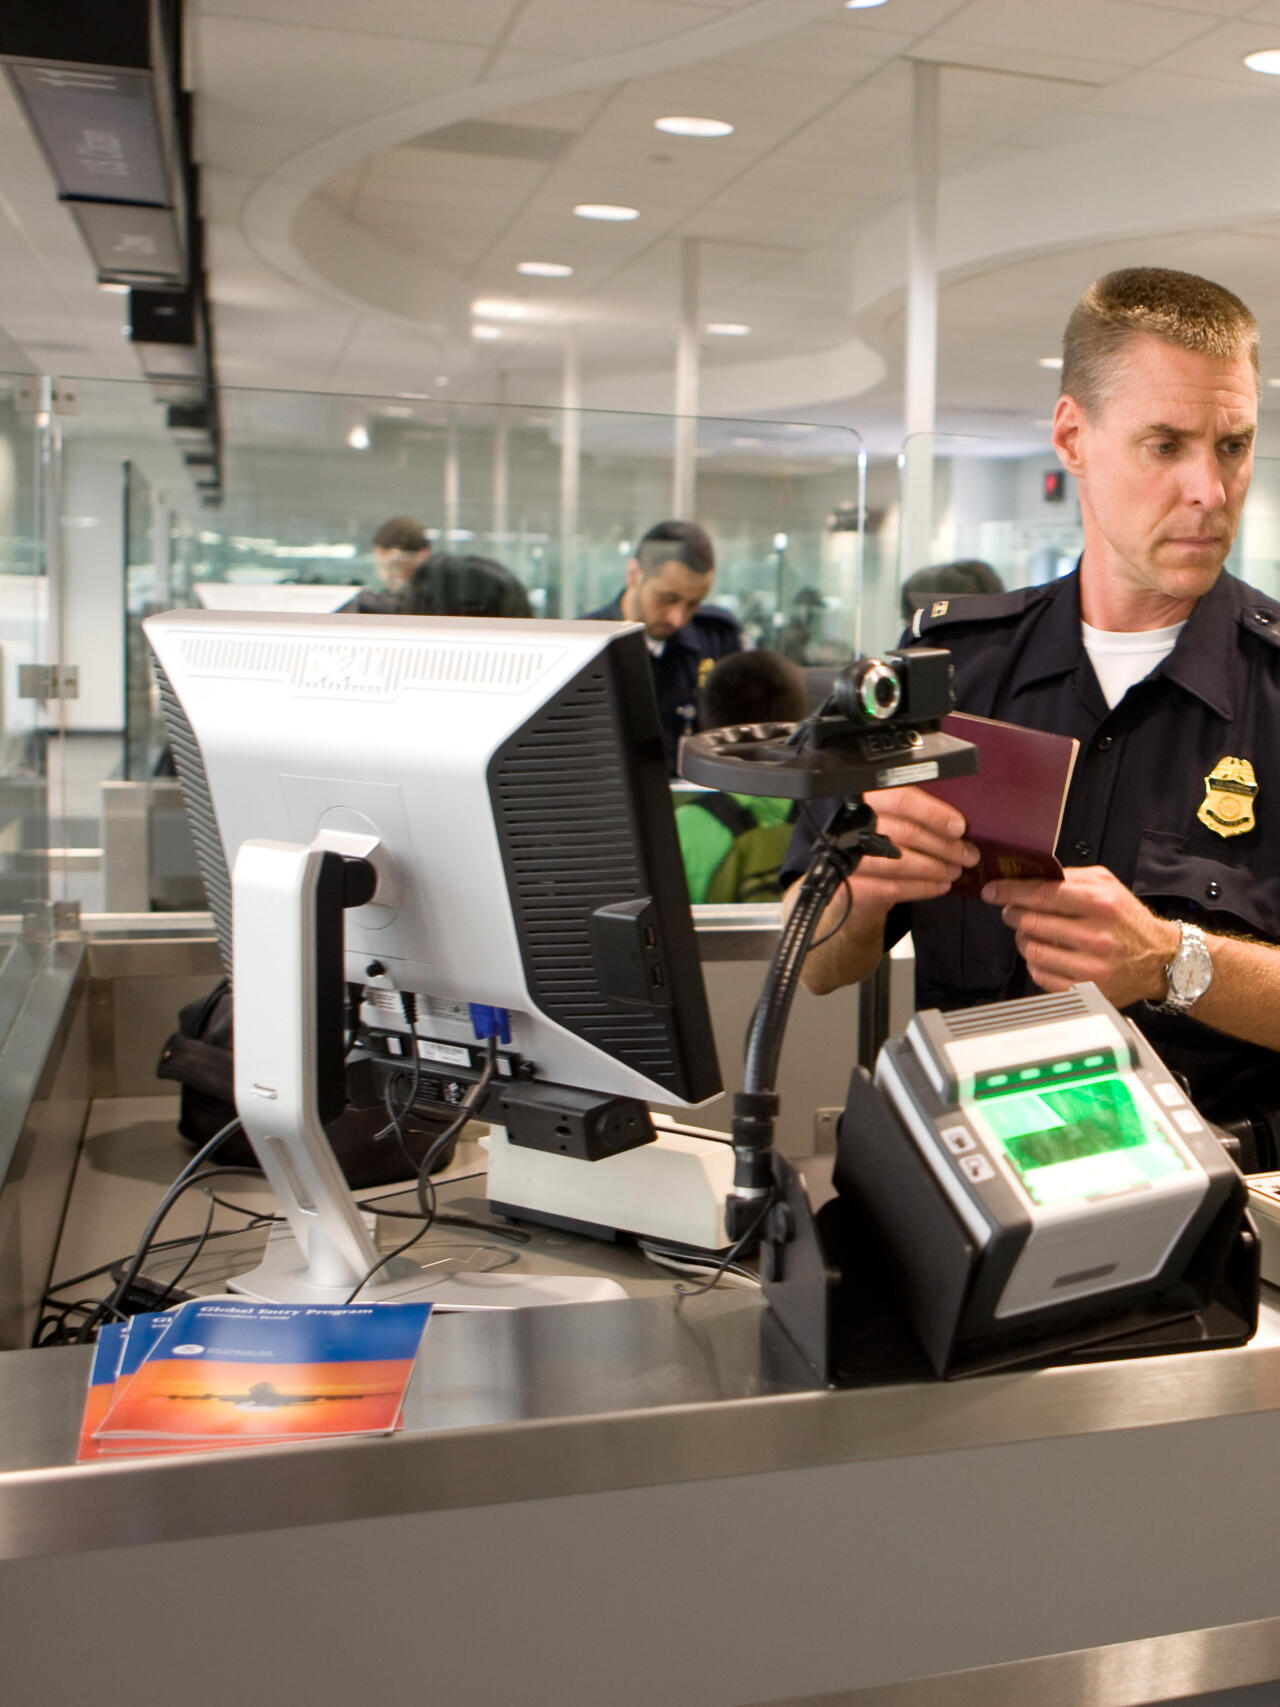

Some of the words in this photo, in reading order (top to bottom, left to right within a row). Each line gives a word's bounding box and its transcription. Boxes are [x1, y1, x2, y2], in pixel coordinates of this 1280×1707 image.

[200, 1306, 255, 1315] Global
[258, 1308, 302, 1316] Entry
[305, 1308, 374, 1317] Program
